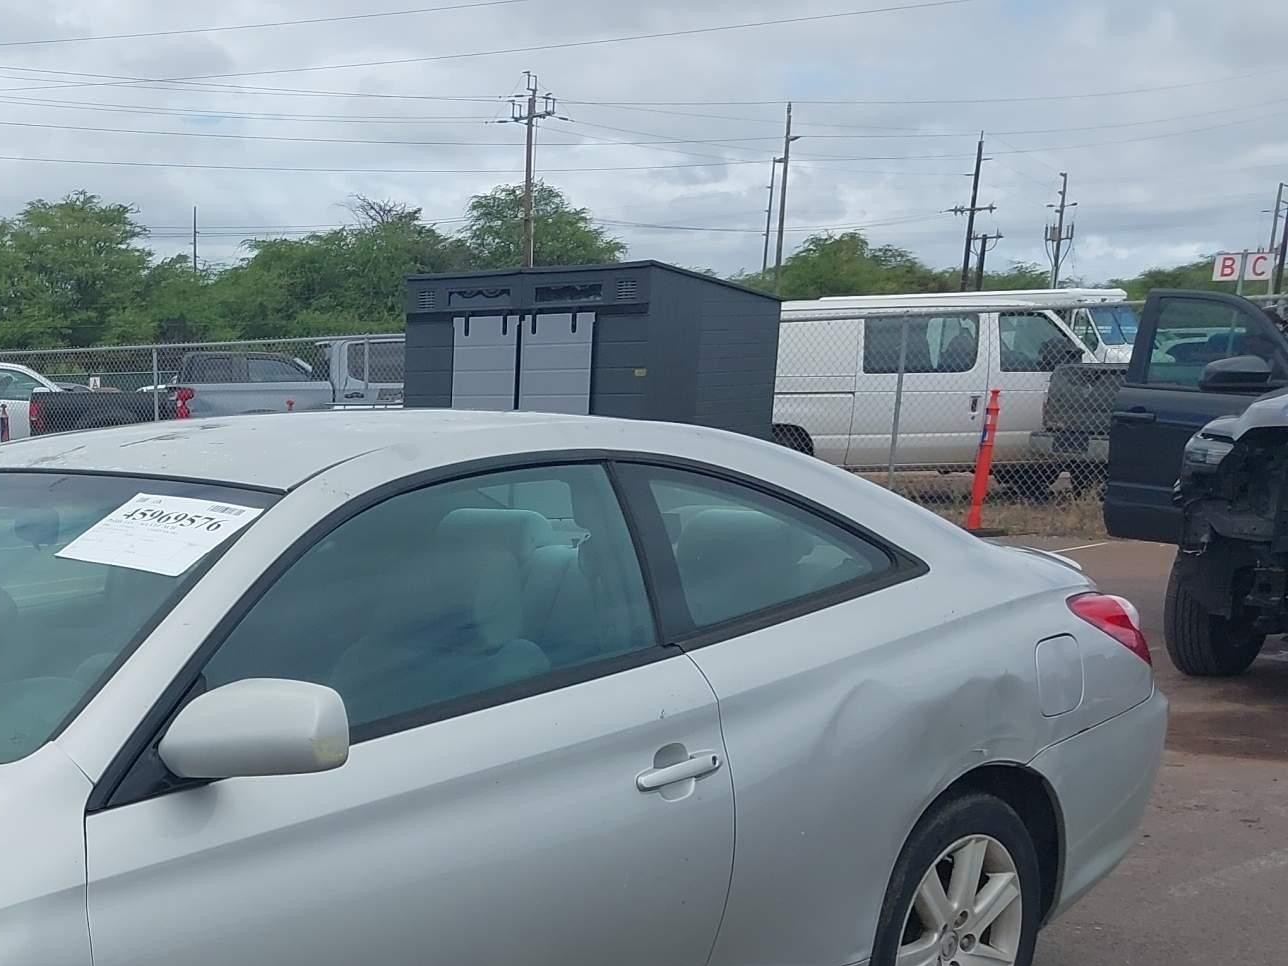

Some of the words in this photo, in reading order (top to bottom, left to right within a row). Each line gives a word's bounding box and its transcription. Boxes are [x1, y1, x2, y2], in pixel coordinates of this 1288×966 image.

[1220, 257, 1235, 277] B
[1252, 255, 1268, 276] C
[122, 507, 230, 532] 45969576
